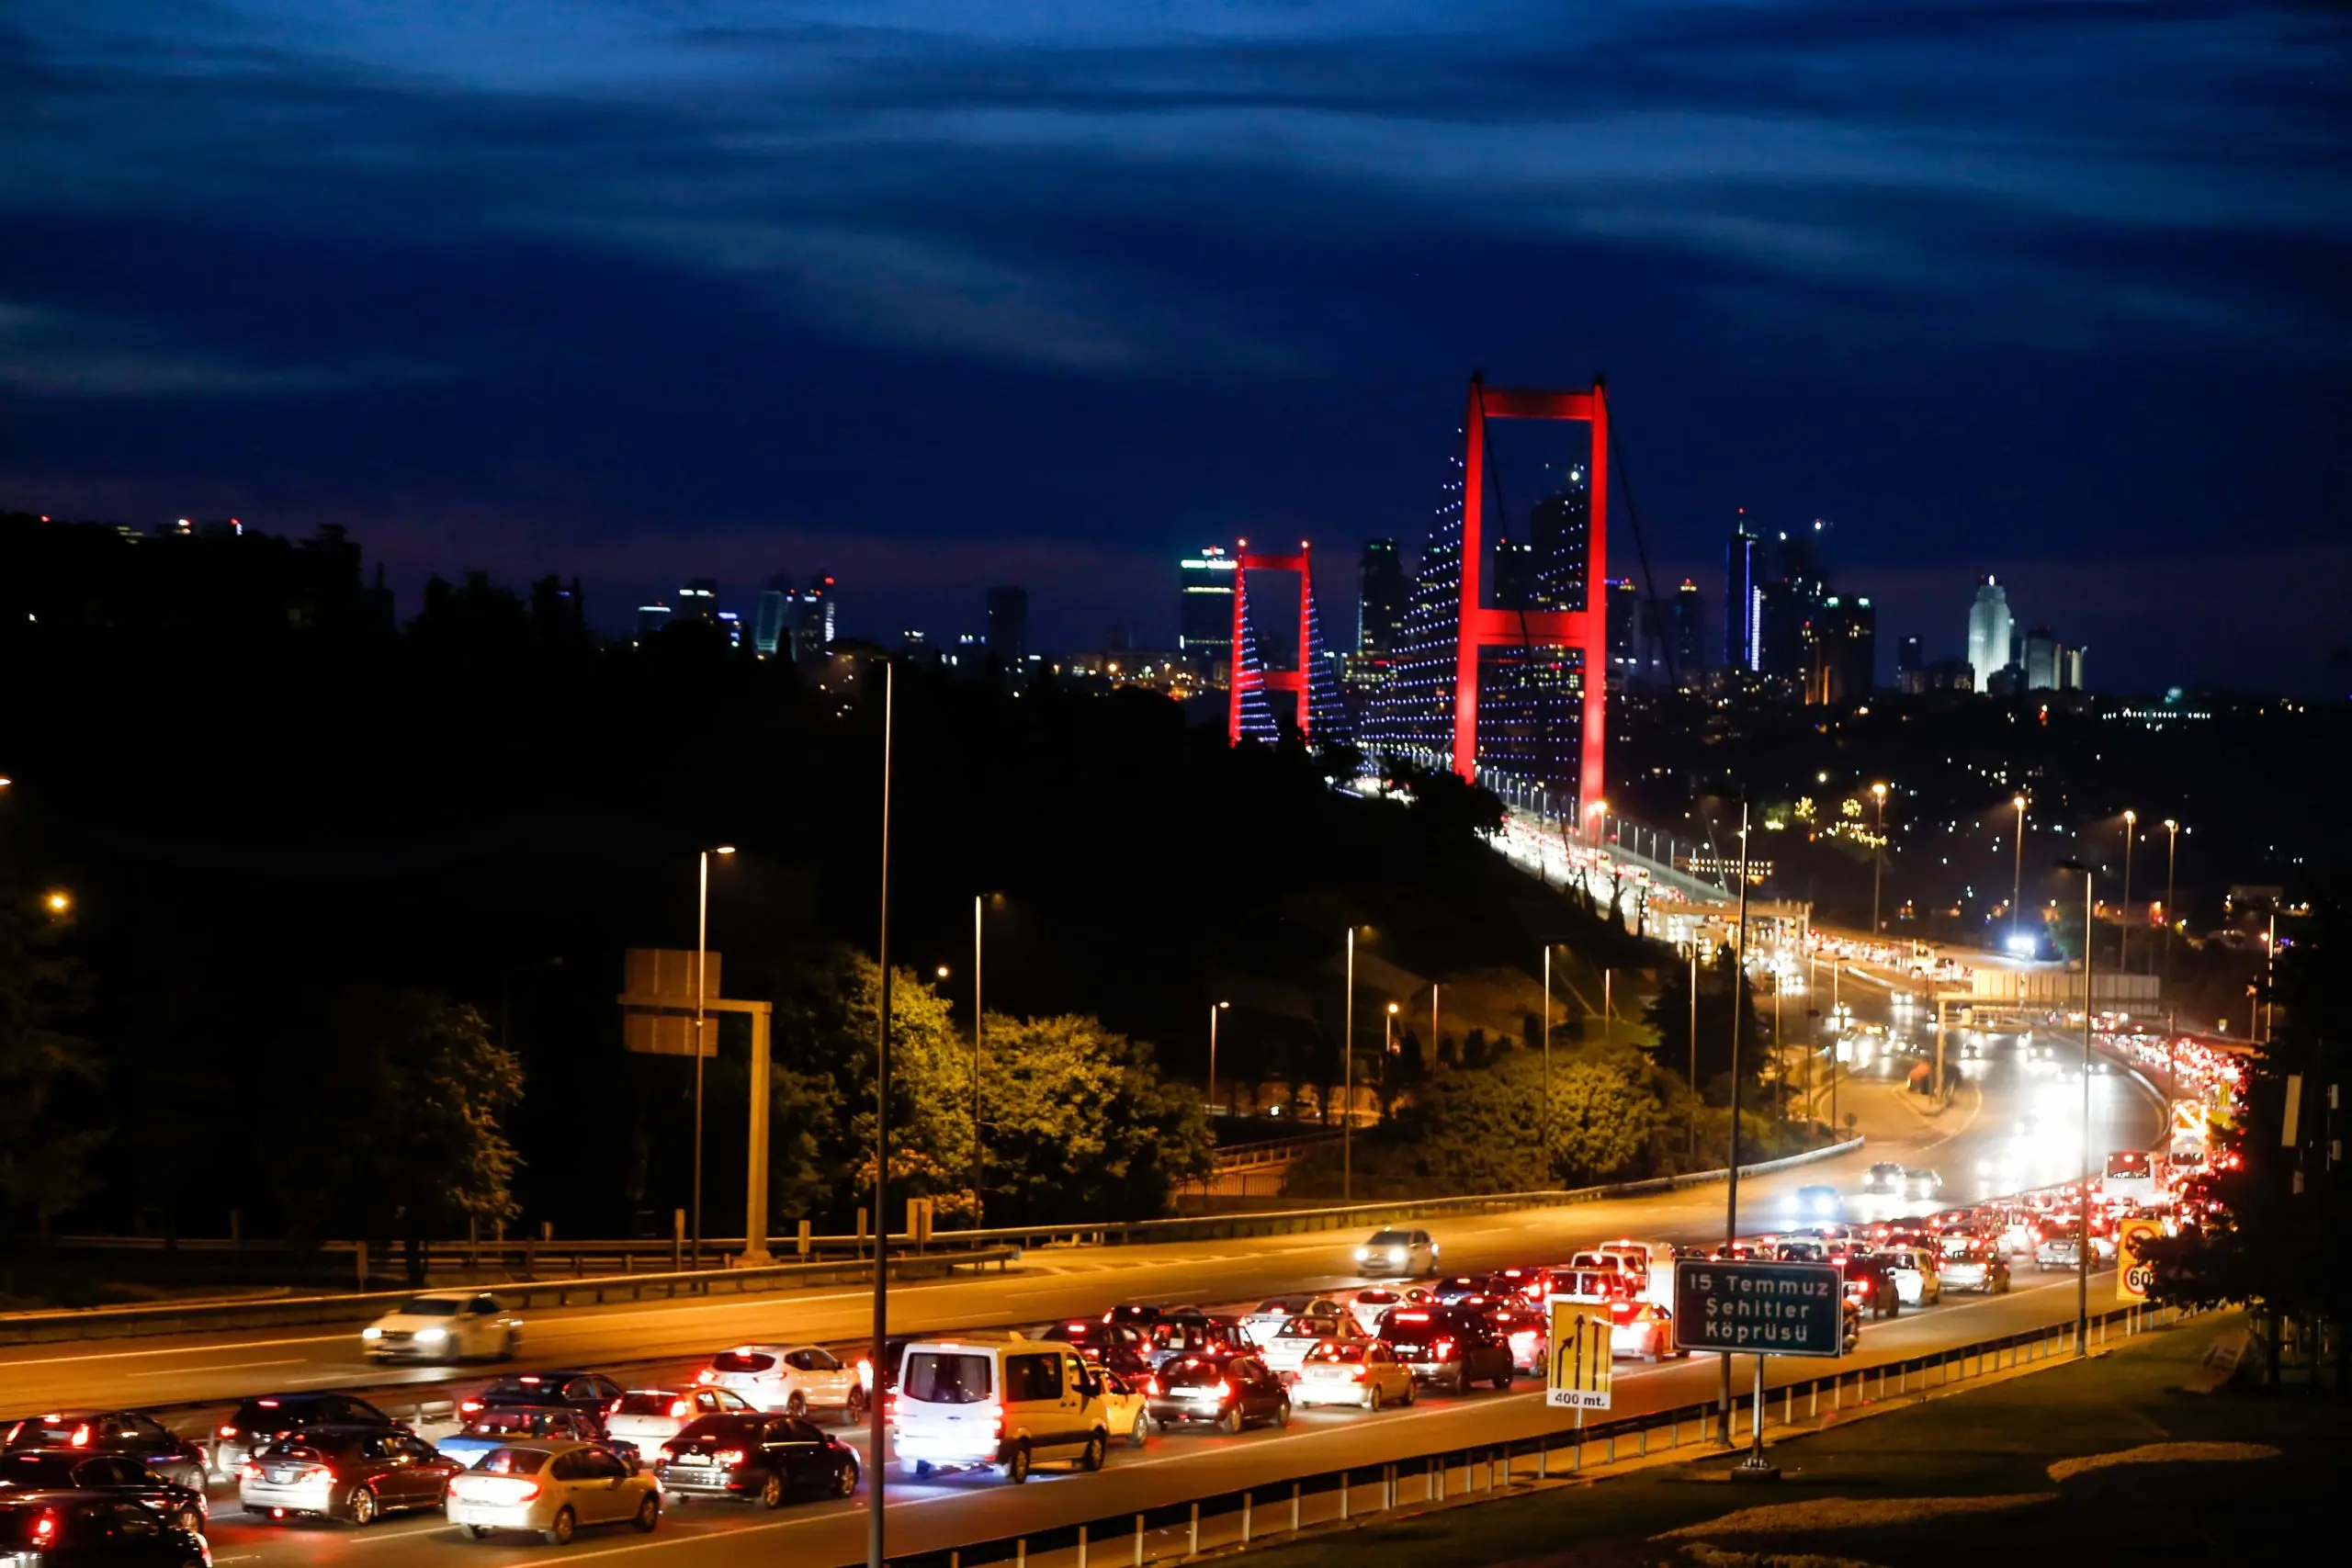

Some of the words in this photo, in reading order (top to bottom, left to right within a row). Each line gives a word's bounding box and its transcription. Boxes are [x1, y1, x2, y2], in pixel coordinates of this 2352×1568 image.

[1690, 1273, 1713, 1291] 15
[1725, 1275, 1828, 1296] Temmuz
[2129, 1269, 2152, 1287] 60
[1705, 1298, 1810, 1319] Şehitler
[1705, 1321, 1808, 1343] Köprüsü
[1555, 1393, 1579, 1404] 400
[1583, 1395, 1605, 1406] mt.
